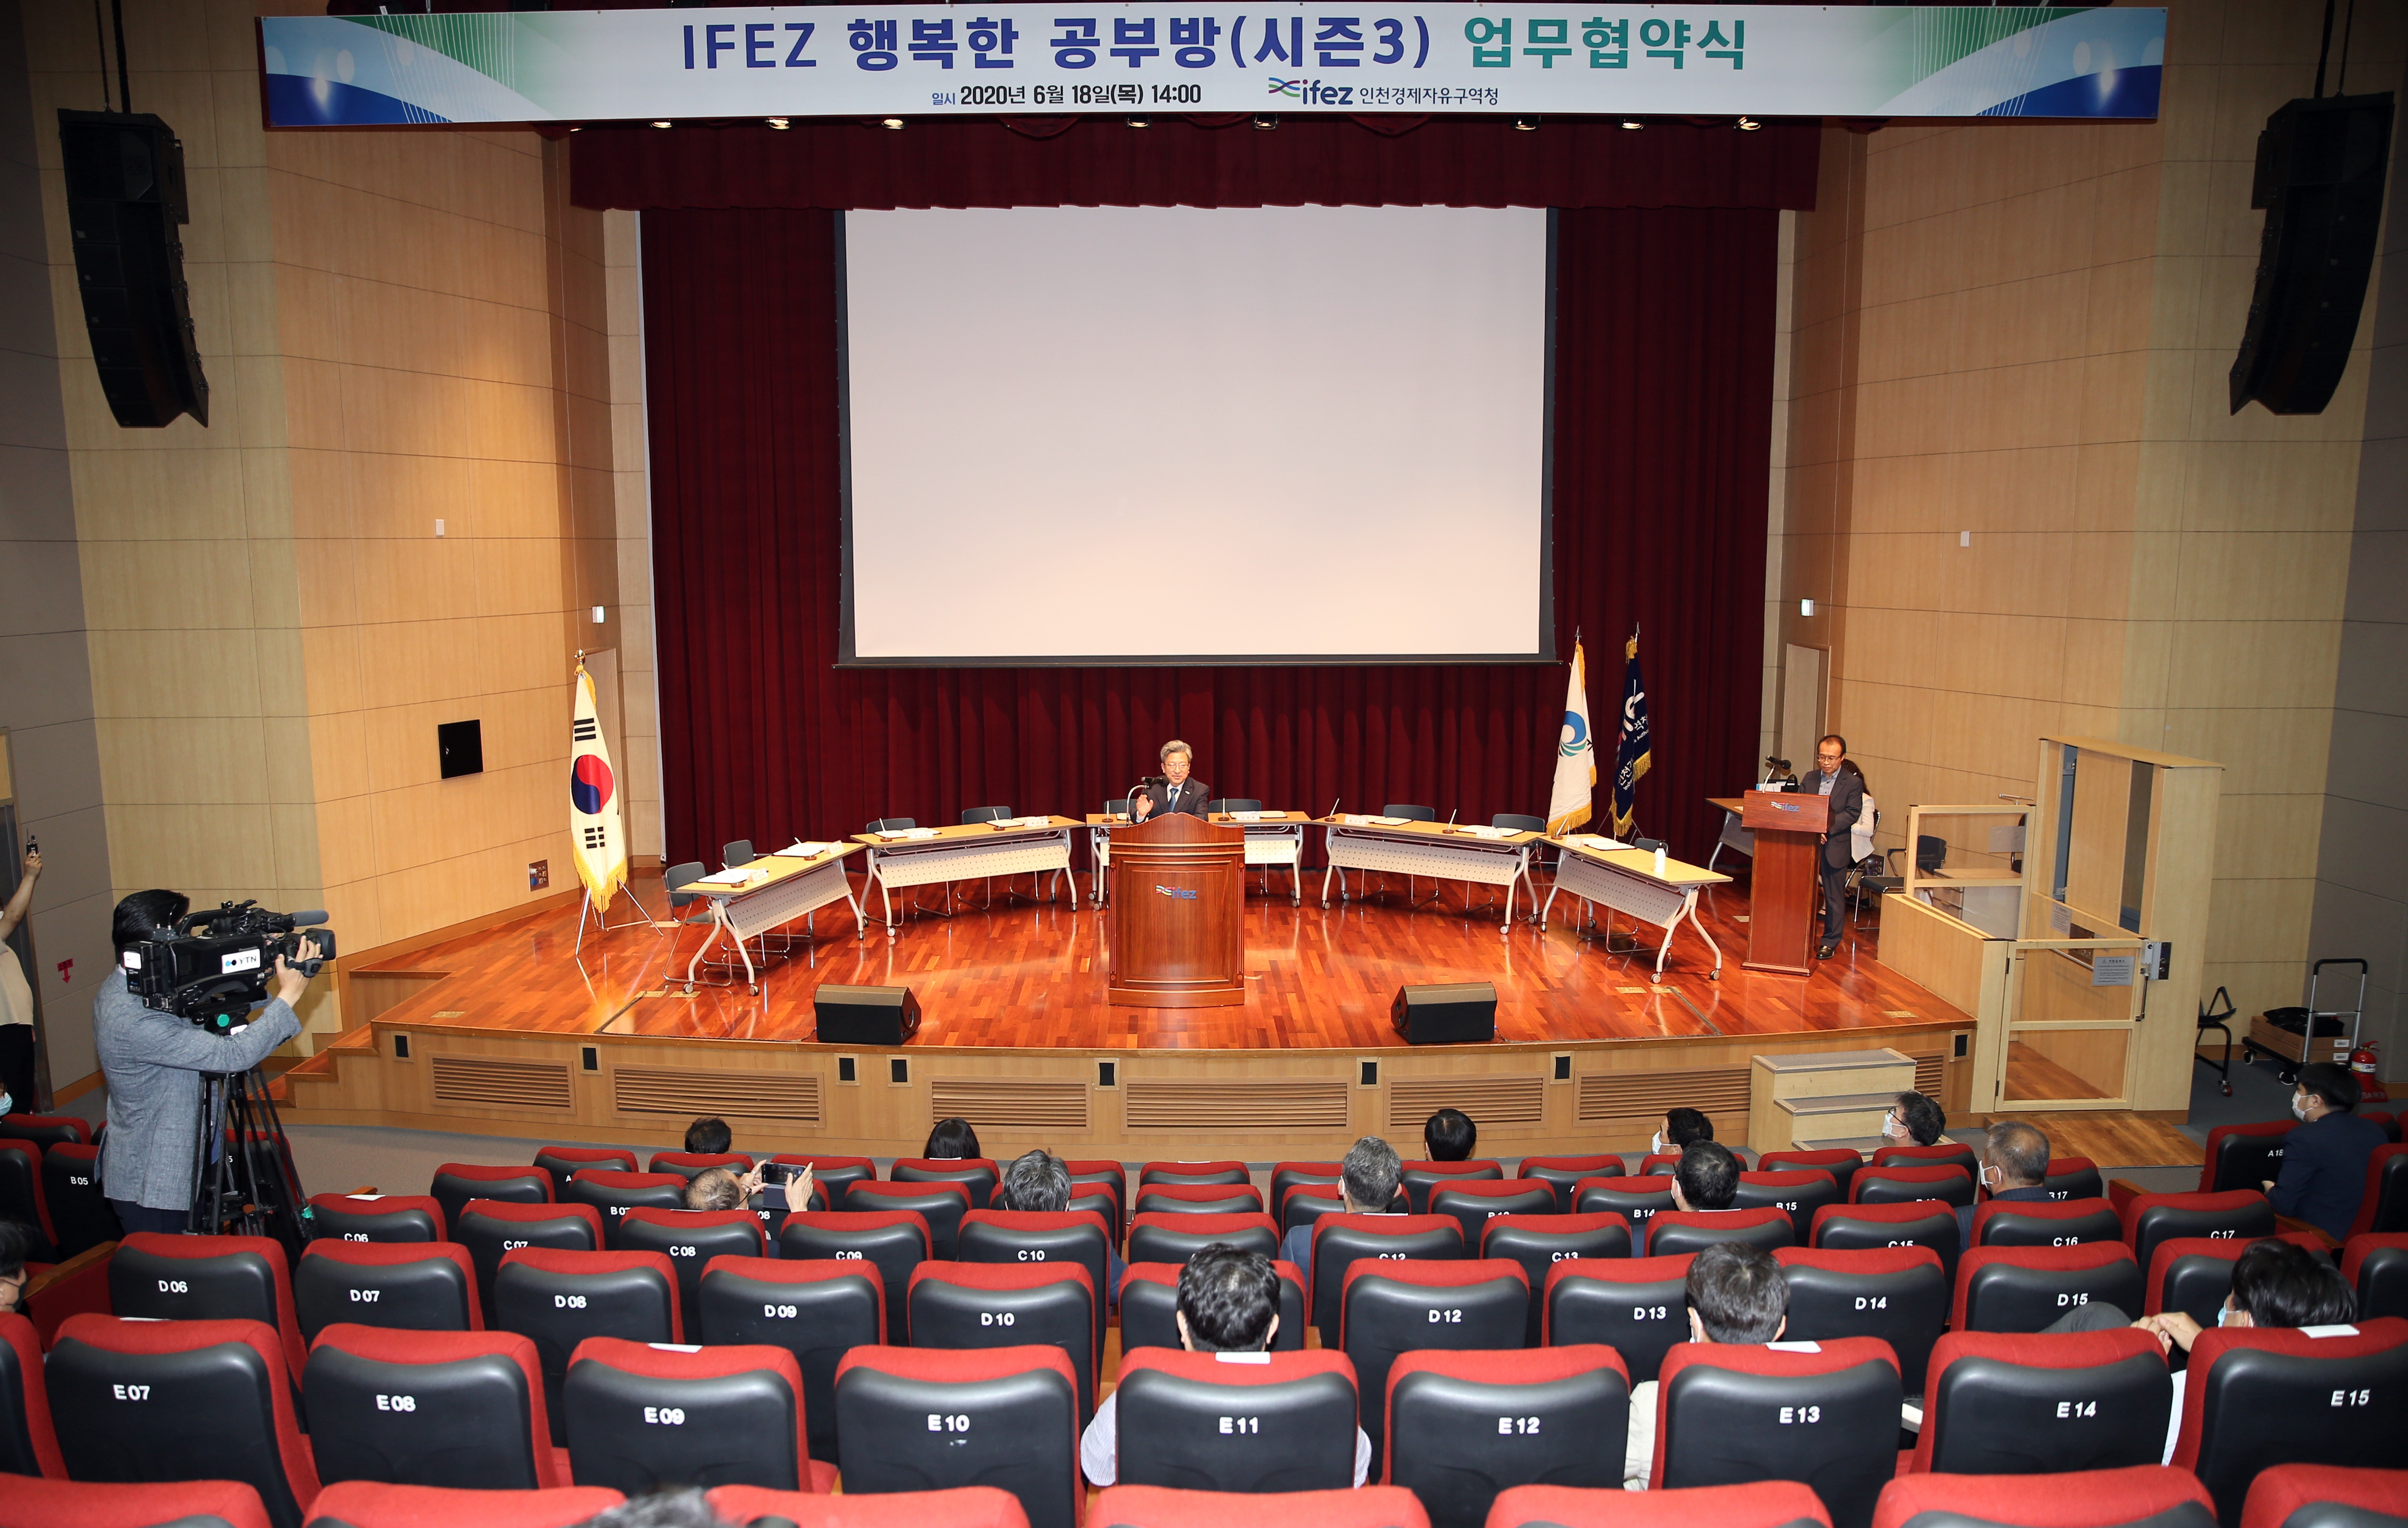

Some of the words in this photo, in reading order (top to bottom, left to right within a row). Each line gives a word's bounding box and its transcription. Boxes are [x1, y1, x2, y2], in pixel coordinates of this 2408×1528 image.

[683, 23, 816, 69] IFEZ
[847, 17, 1019, 71] 행복한
[1050, 16, 1430, 69] 공부방(시즌3)
[1464, 17, 1744, 69] 업무협약식
[932, 92, 956, 105] 일시
[960, 85, 1026, 105] 2020년
[1033, 85, 1064, 104] 6월
[1072, 84, 1144, 104] 18일(목)
[1151, 84, 1201, 104] 14:00
[1302, 79, 1354, 105] ifez
[1359, 88, 1499, 106] 인천경제자유구역청
[1782, 802, 1799, 812] ifez
[1172, 886, 1197, 899] ifez
[239, 955, 257, 965] YTN
